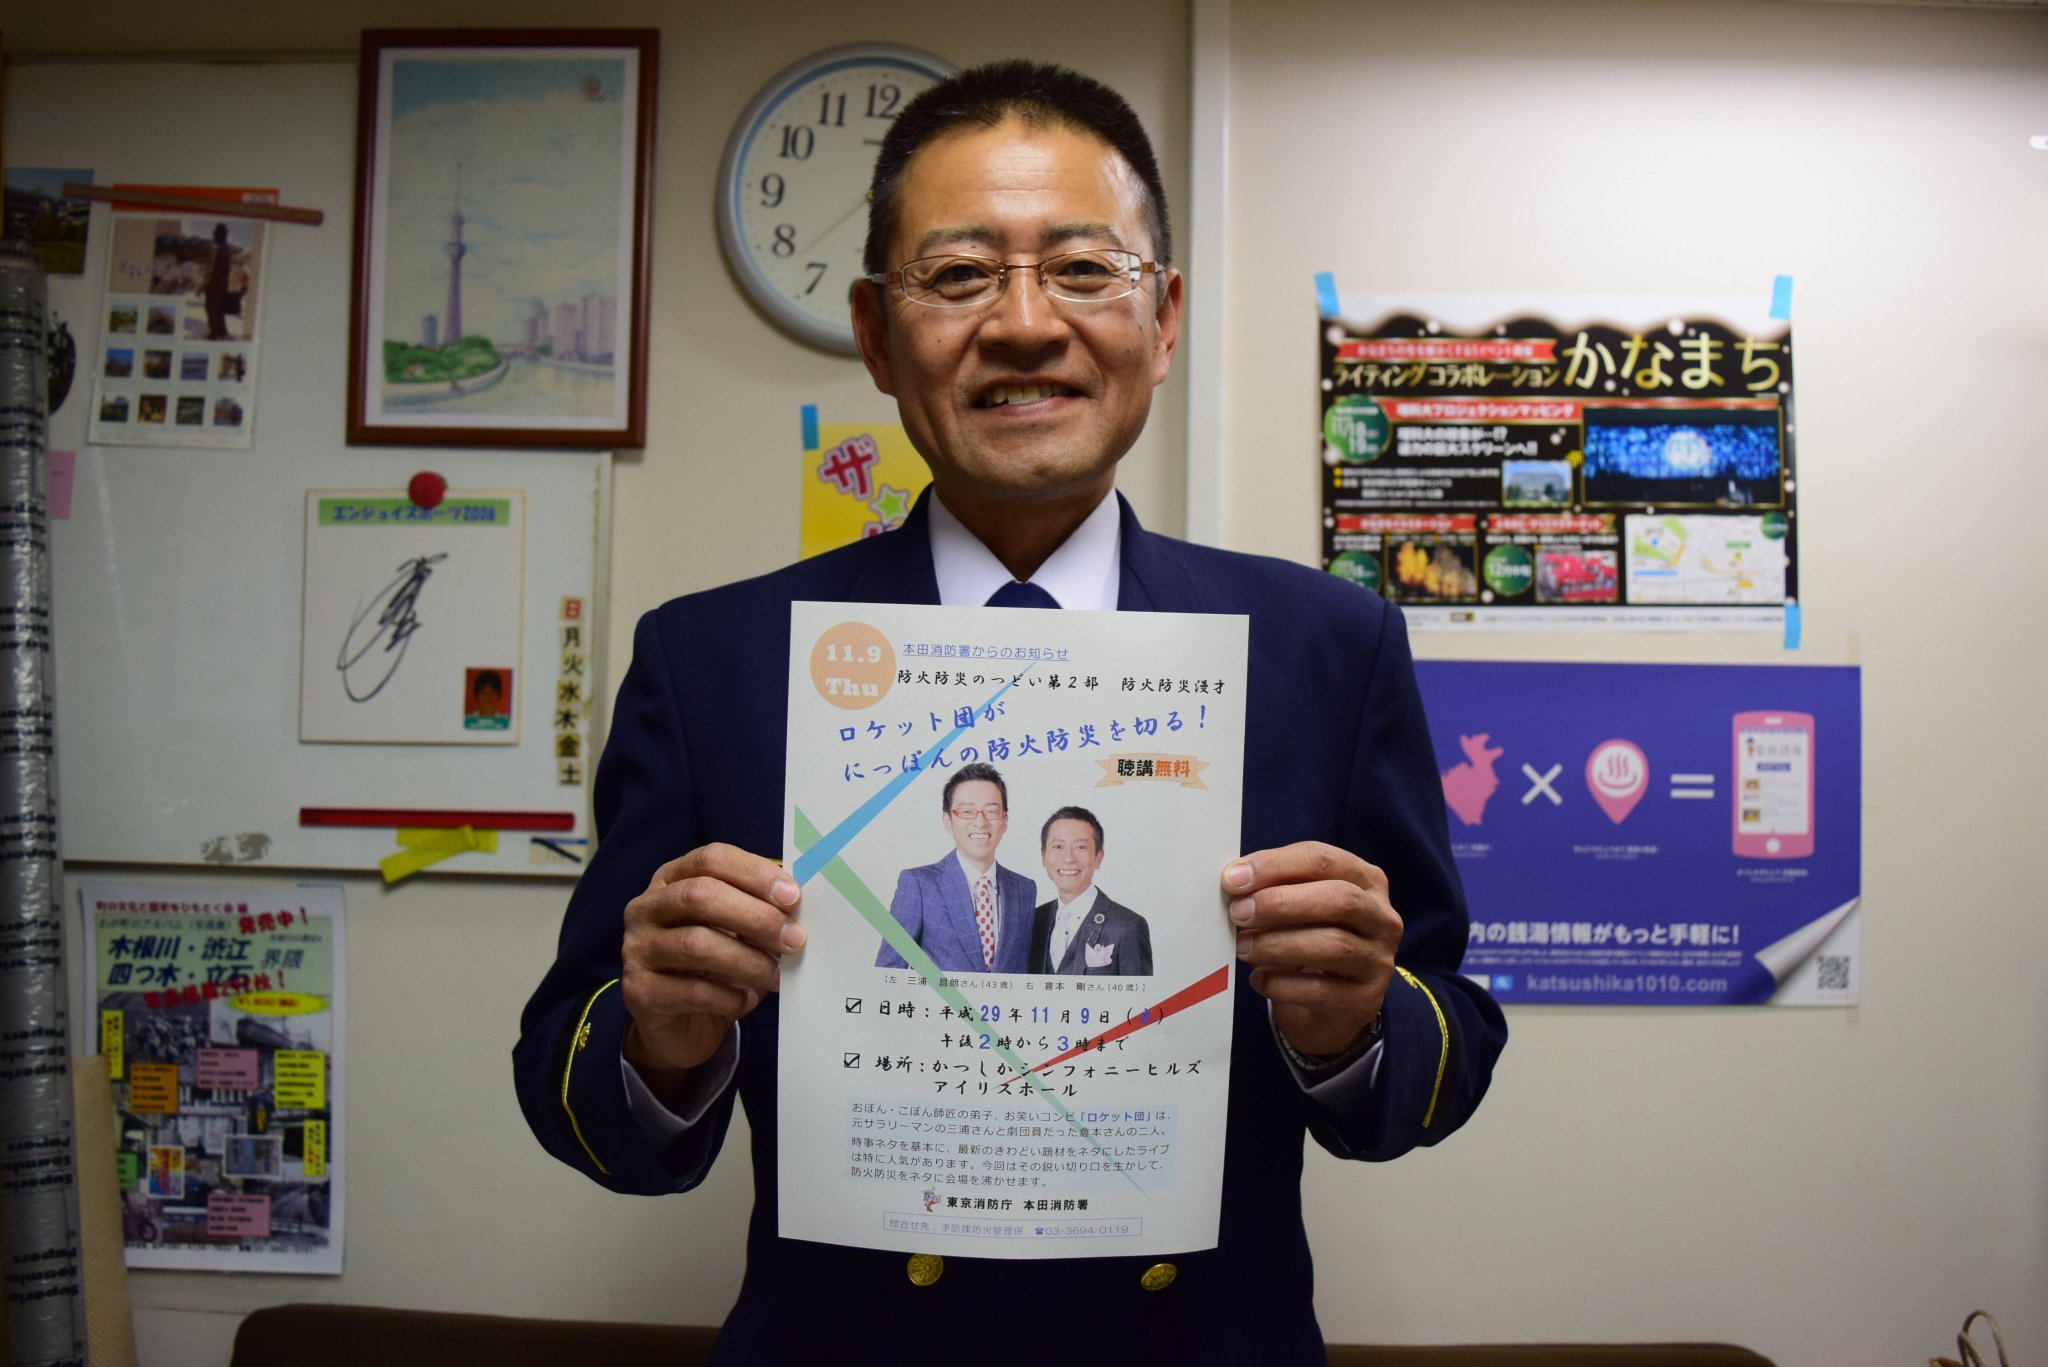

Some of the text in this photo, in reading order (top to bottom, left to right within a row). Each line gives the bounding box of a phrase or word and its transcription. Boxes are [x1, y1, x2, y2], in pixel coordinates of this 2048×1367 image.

[817, 92, 847, 127] 11
[865, 83, 901, 121] 12
[780, 125, 814, 160] 10
[760, 173, 785, 208] 9
[771, 223, 796, 258] 8
[805, 262, 828, 295] 7
[1333, 332, 1780, 390] ライティングコラボレーション かなまち
[823, 439, 875, 496] ザ
[826, 643, 881, 663] 11.9
[903, 643, 1069, 660] 本田消防署からのお知らせ
[825, 677, 879, 697] Thu
[897, 669, 1225, 695] 防火防災のつどい第2部 防火防災漫才
[839, 701, 1006, 742] ロケット団が
[844, 704, 1206, 782] にっぽんの防火防災を切る！
[1117, 758, 1191, 778] 聴講無料
[108, 935, 253, 961] 木根川・渋江
[1527, 974, 1728, 993] katsushika1010.com
[940, 1033, 1129, 1052] 午後2時から3時まで
[933, 1080, 1078, 1098] アイリスホール
[946, 1196, 1089, 1212] 東京消防庁 本田消防署
